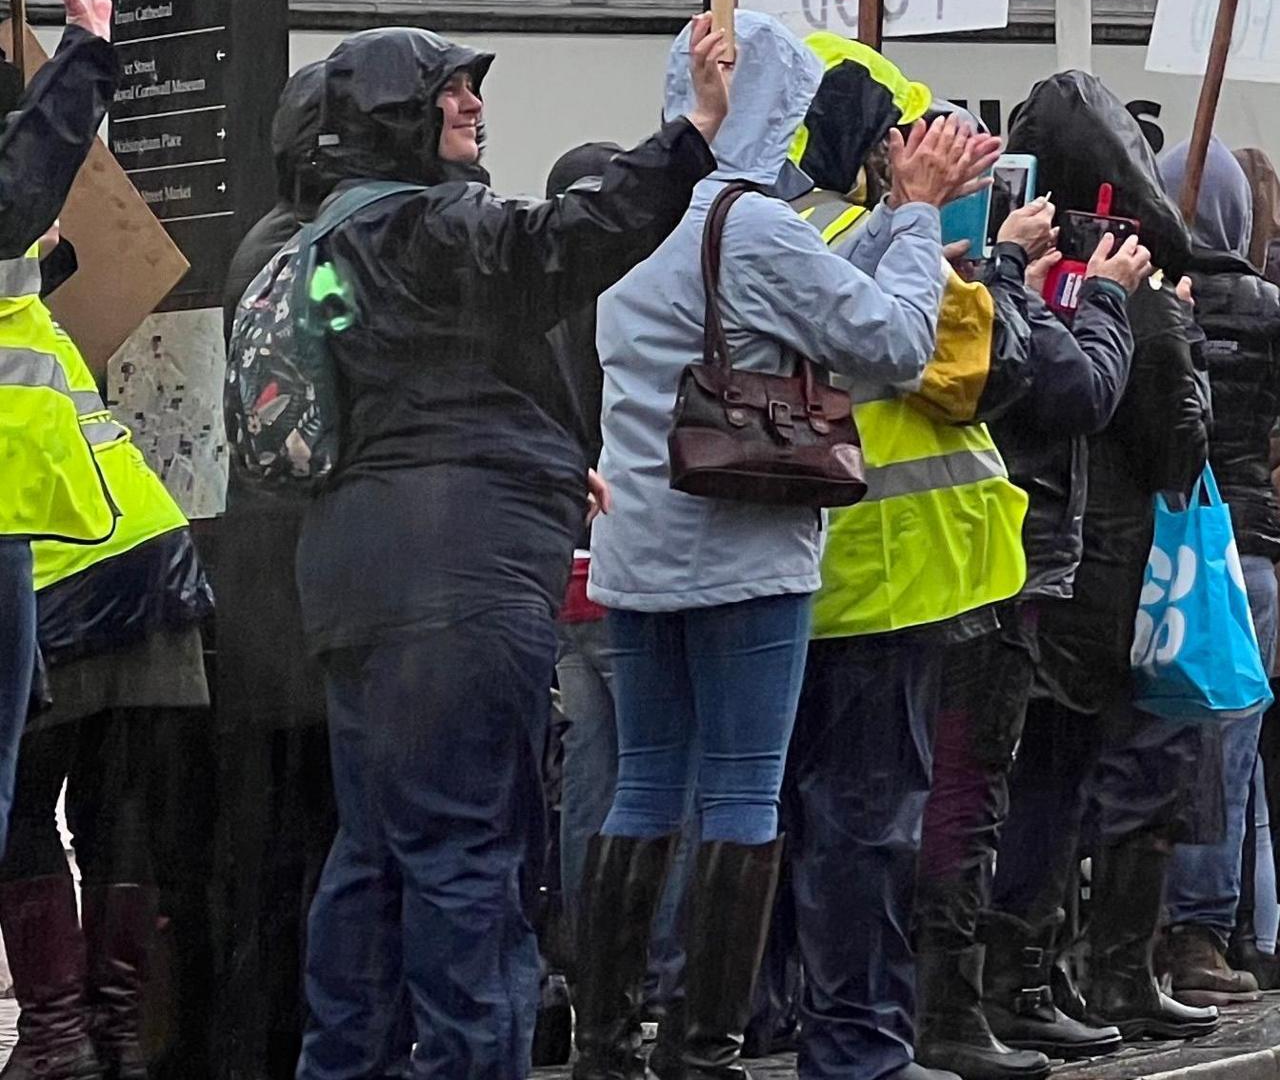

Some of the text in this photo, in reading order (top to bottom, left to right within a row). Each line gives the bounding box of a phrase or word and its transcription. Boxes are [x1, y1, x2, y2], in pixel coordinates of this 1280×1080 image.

[135, 80, 171, 98] Cornwall
[171, 78, 206, 94] Museum
[161, 133, 182, 148] Place
[164, 185, 192, 201] Market
